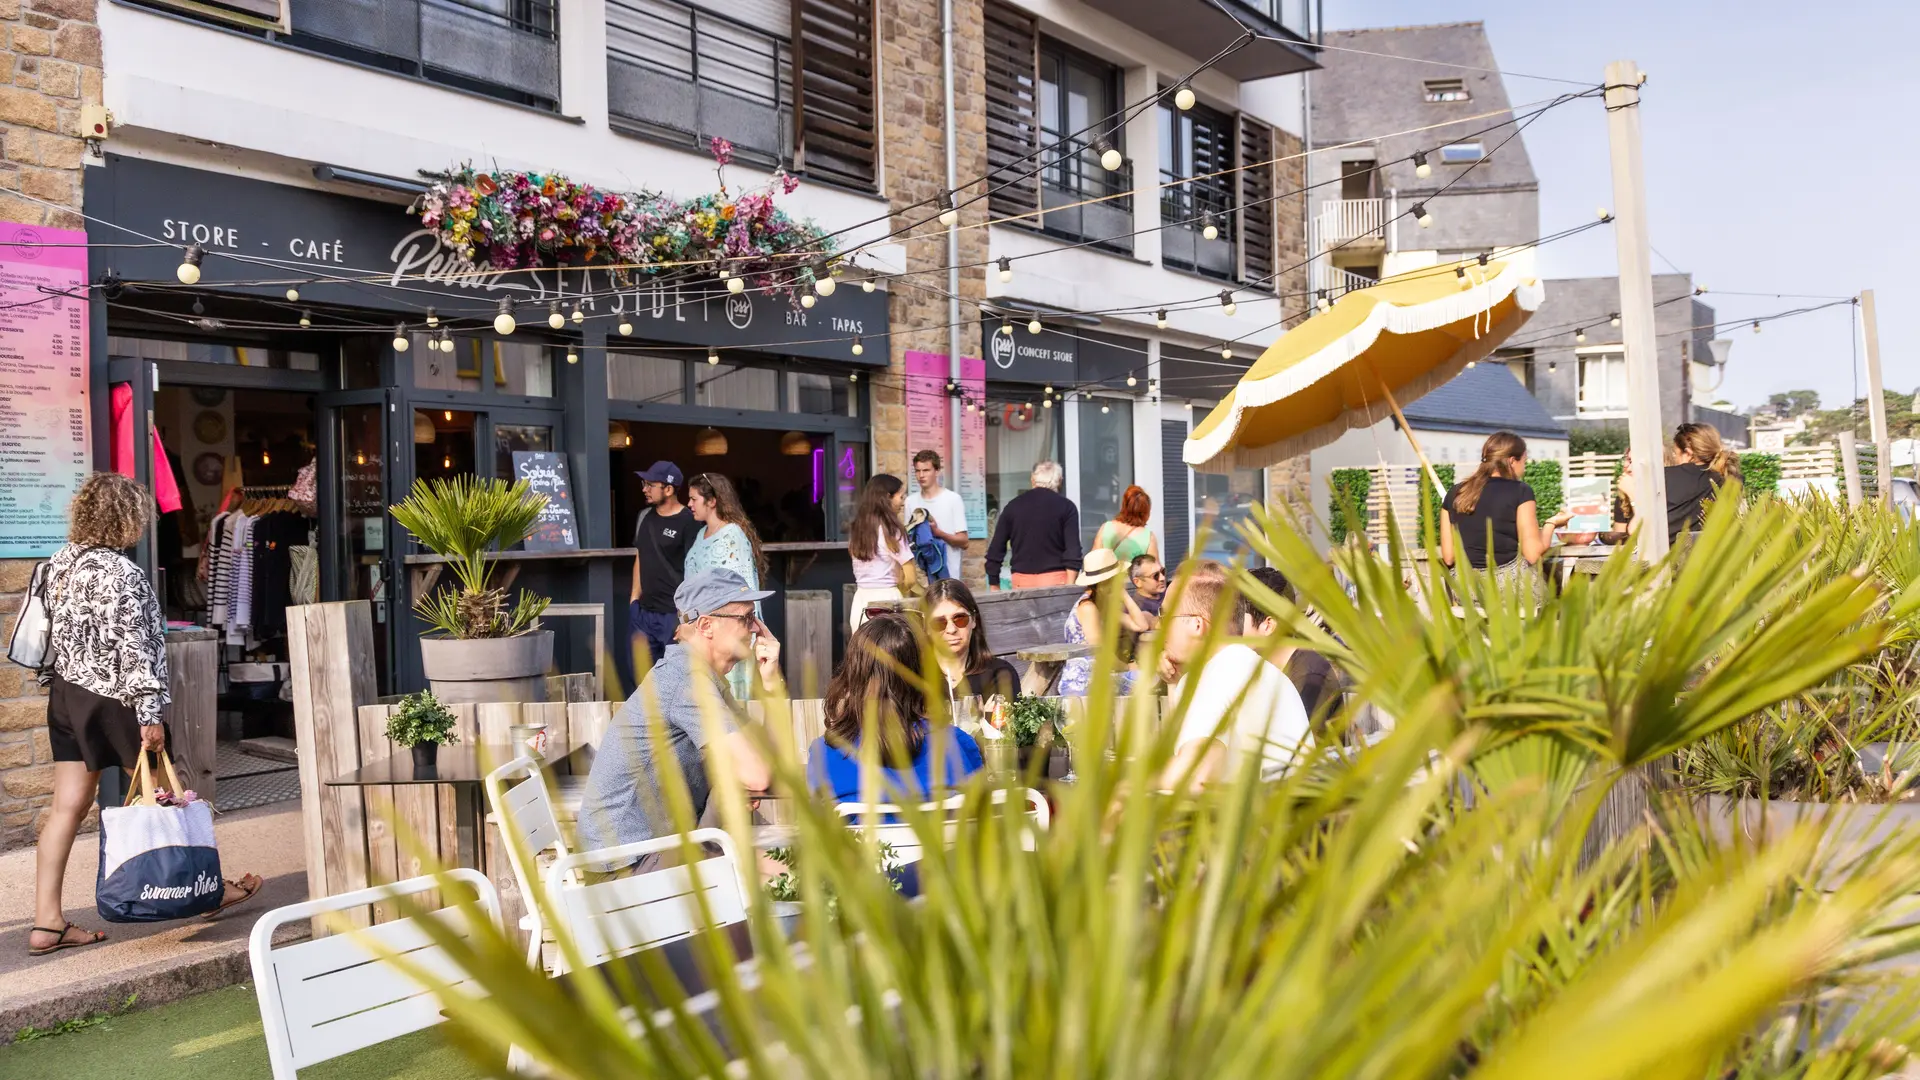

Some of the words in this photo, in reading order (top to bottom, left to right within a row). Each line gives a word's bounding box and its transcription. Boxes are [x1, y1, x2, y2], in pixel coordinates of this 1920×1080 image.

[163, 219, 238, 248] STORE
[289, 238, 343, 263] CAFÉ
[786, 311, 807, 326] BAR
[831, 317, 863, 334] TAPAS
[1017, 346, 1050, 360] CONCEPT
[1053, 351, 1074, 363] STORE
[140, 884, 193, 900] Summer
[194, 870, 218, 897] Vibes
